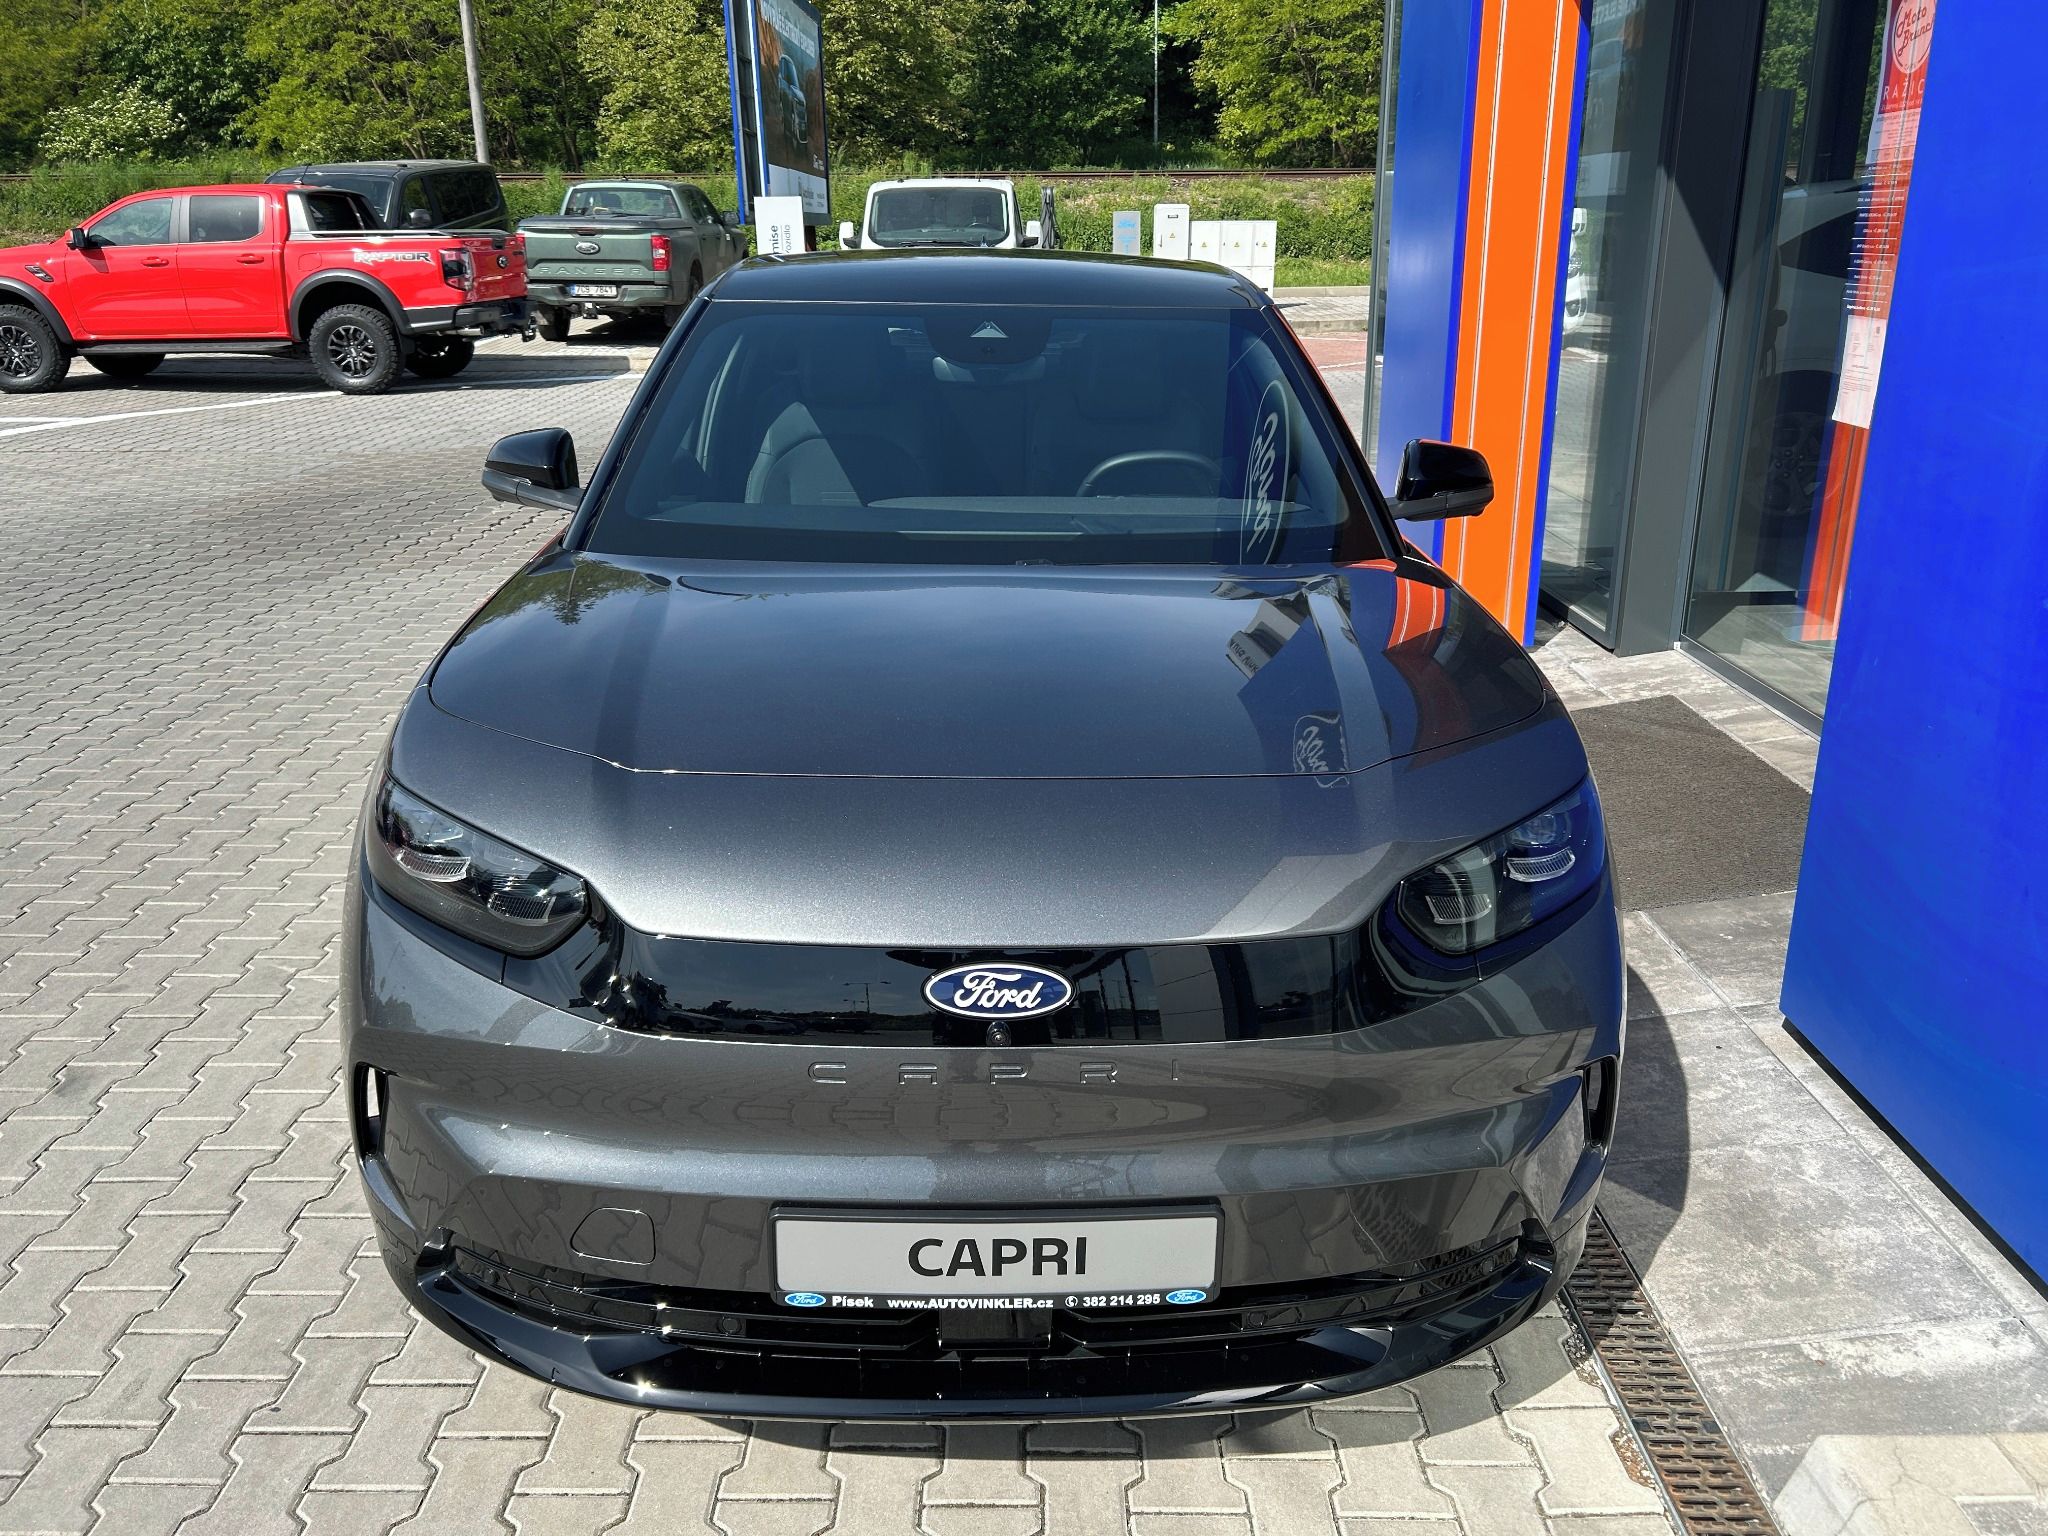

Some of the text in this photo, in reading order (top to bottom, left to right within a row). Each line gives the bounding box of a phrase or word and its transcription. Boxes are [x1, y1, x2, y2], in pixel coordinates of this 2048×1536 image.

[352, 248, 435, 266] RAPTOR
[539, 266, 646, 276] RANGER
[954, 971, 1044, 1009] Ford
[808, 1059, 1179, 1085] CAPRI
[908, 1237, 1087, 1276] CAPRI
[832, 1296, 874, 1308] Písek
[887, 1298, 1054, 1309] www.AUTOVINKLER.cz
[1083, 1296, 1107, 1307] 382
[1110, 1295, 1133, 1306] 214
[1136, 1293, 1161, 1305] 295
